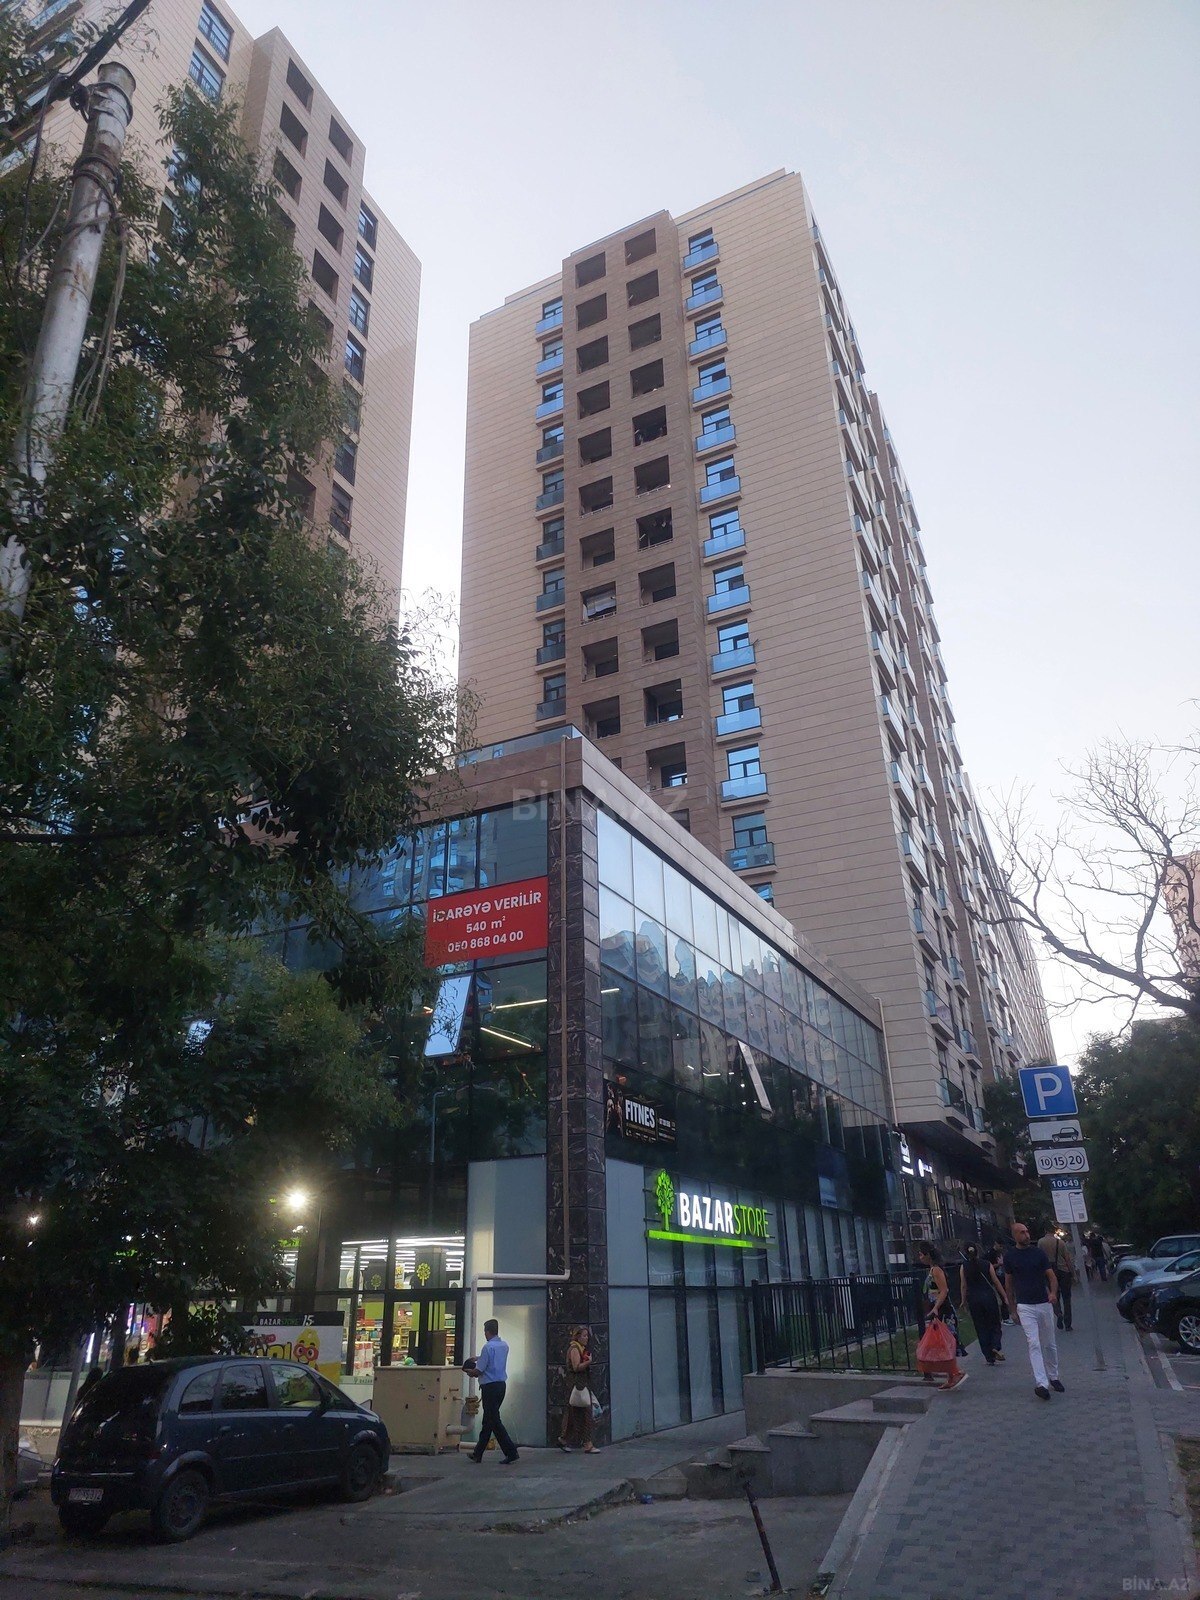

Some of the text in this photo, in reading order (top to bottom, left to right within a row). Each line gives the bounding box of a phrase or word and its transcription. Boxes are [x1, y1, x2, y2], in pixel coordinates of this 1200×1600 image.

[494, 890, 542, 911] VERİLİR
[466, 921, 487, 934] 540
[447, 930, 524, 953] 050 868 04 00
[1034, 1072, 1063, 1111] P
[625, 1099, 656, 1129] FITNES
[1040, 1155, 1083, 1167] 10 15 20
[1052, 1179, 1080, 1188] 10649
